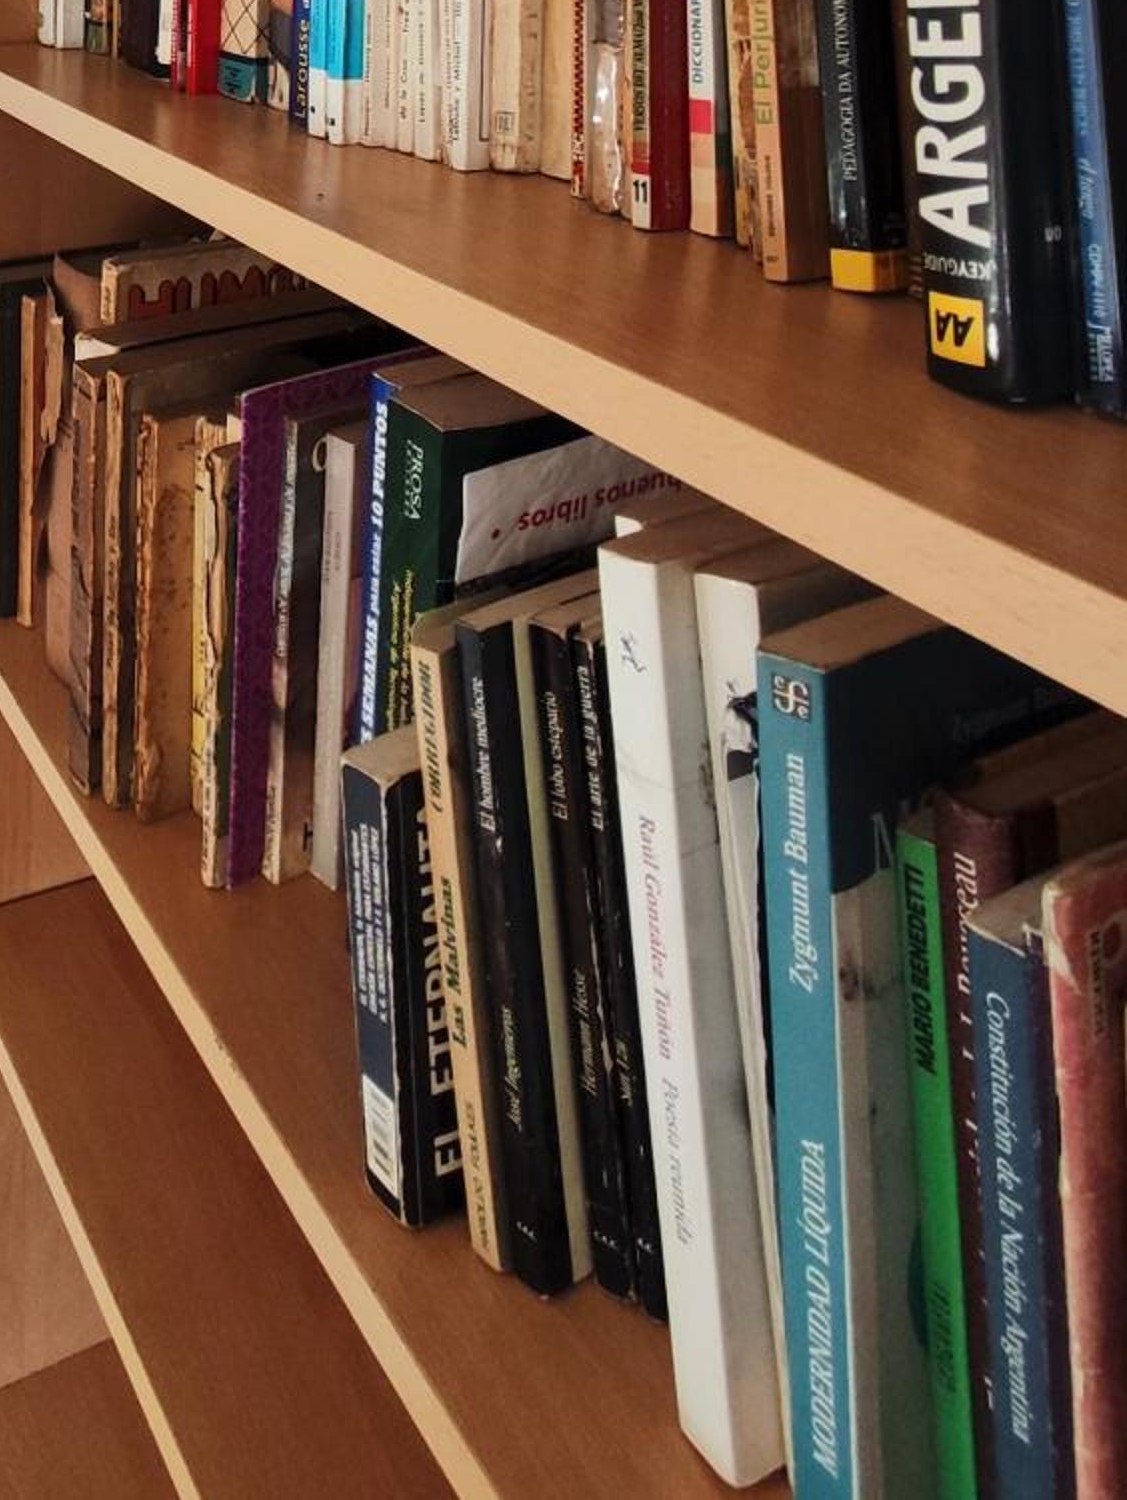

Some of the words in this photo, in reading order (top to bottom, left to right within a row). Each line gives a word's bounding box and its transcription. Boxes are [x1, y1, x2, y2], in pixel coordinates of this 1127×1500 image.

[294, 20, 308, 118] Larousse
[838, 71, 852, 92] DA
[754, 100, 774, 125] El
[841, 96, 857, 182] PEDAGOGIA
[633, 179, 648, 204] 11
[936, 308, 975, 347] AA
[372, 401, 389, 498] PUNTOS
[407, 443, 424, 520] PROSA
[371, 501, 384, 529] 10
[517, 496, 588, 531] libros
[360, 614, 380, 727] SEMANAS
[575, 664, 596, 721] guerra
[472, 674, 490, 748] mediocre
[546, 690, 563, 760] estepario
[582, 721, 595, 741] la
[476, 750, 493, 809] hombre
[549, 762, 565, 799] lobo
[584, 743, 598, 768] de
[553, 800, 568, 821] El
[587, 770, 603, 806] arte
[782, 752, 807, 865] Bauman
[480, 810, 495, 832] El
[591, 811, 604, 832] El
[440, 875, 462, 997] Malvinas
[784, 866, 819, 994] Zygmunt
[903, 862, 931, 992] BENEDETTI
[451, 1006, 468, 1049] Las
[909, 990, 937, 1076] MARIO
[986, 991, 1017, 1157] Constitución
[996, 1155, 1022, 1191] de
[795, 1138, 830, 1268] LÍQUIDA
[999, 1188, 1024, 1218] la
[999, 1218, 1025, 1315] Nación
[803, 1264, 839, 1480] MODERNIDAD
[1001, 1312, 1036, 1445] Argentina
